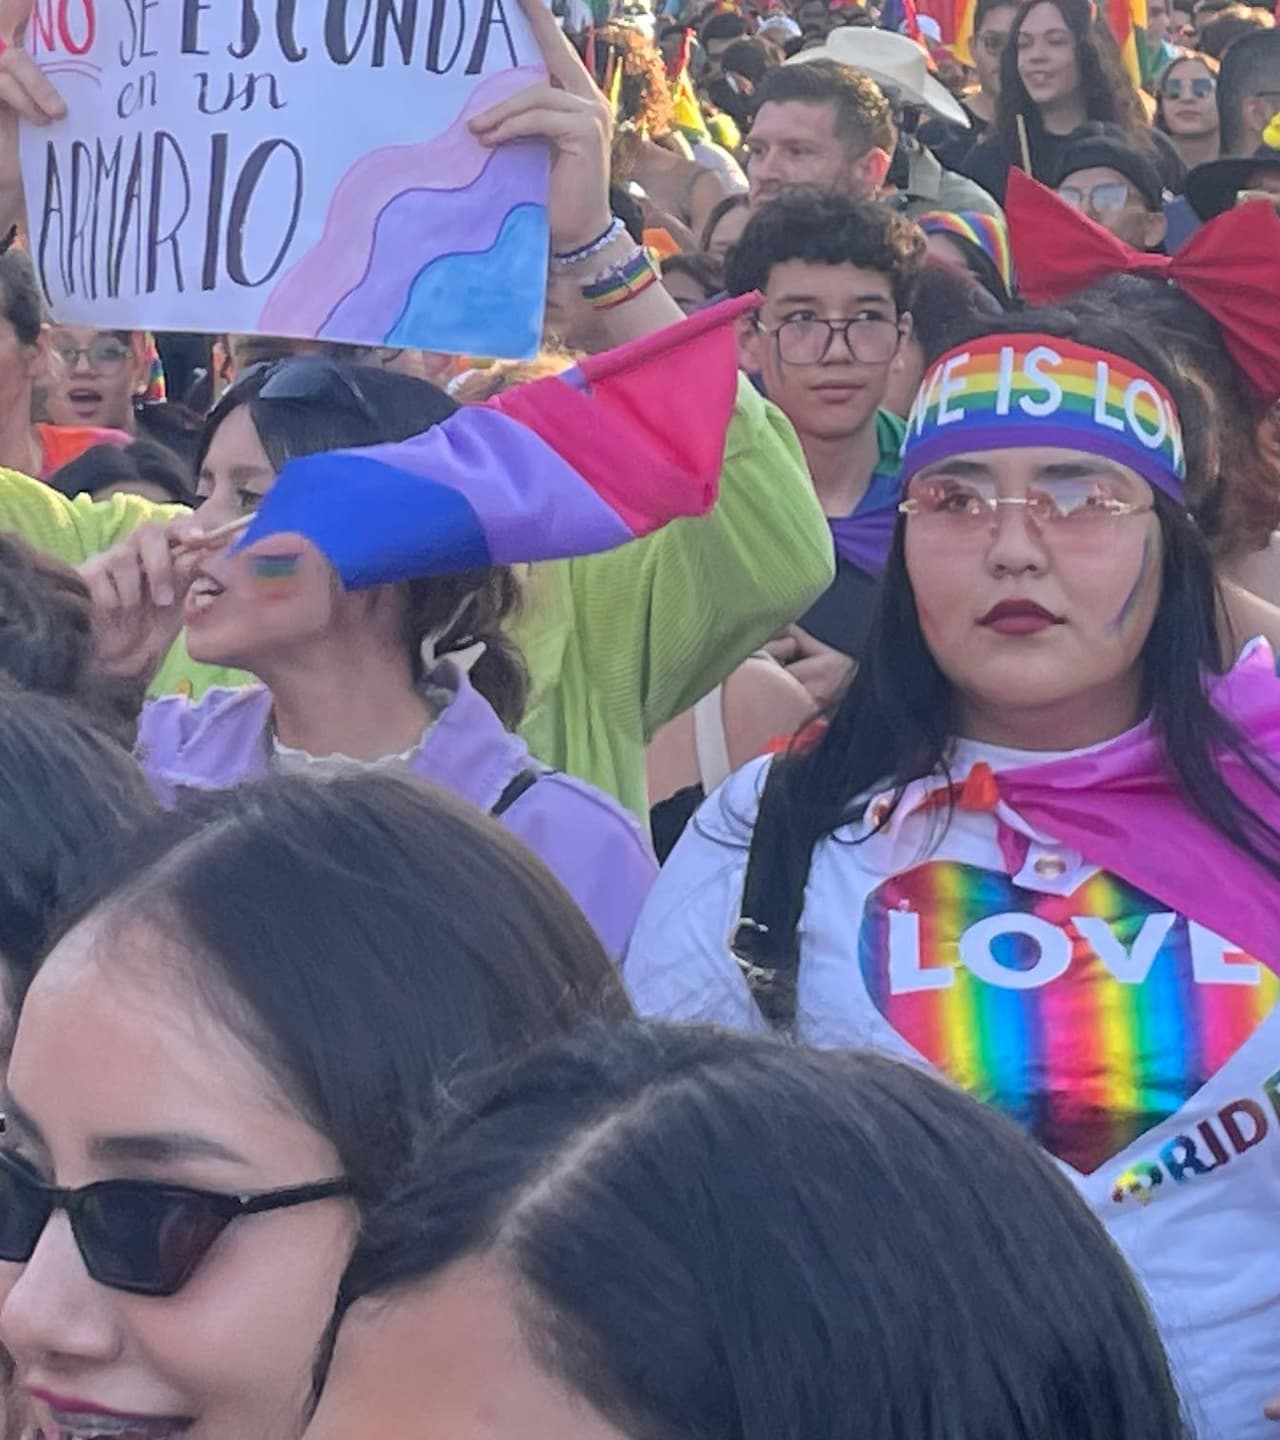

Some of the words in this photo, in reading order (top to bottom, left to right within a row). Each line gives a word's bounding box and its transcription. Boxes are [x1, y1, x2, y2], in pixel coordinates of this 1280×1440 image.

[117, 70, 157, 119] en
[193, 71, 288, 116] un
[38, 130, 304, 308] ARMARIO
[995, 345, 1063, 417] IS
[887, 910, 1262, 996] LOVE
